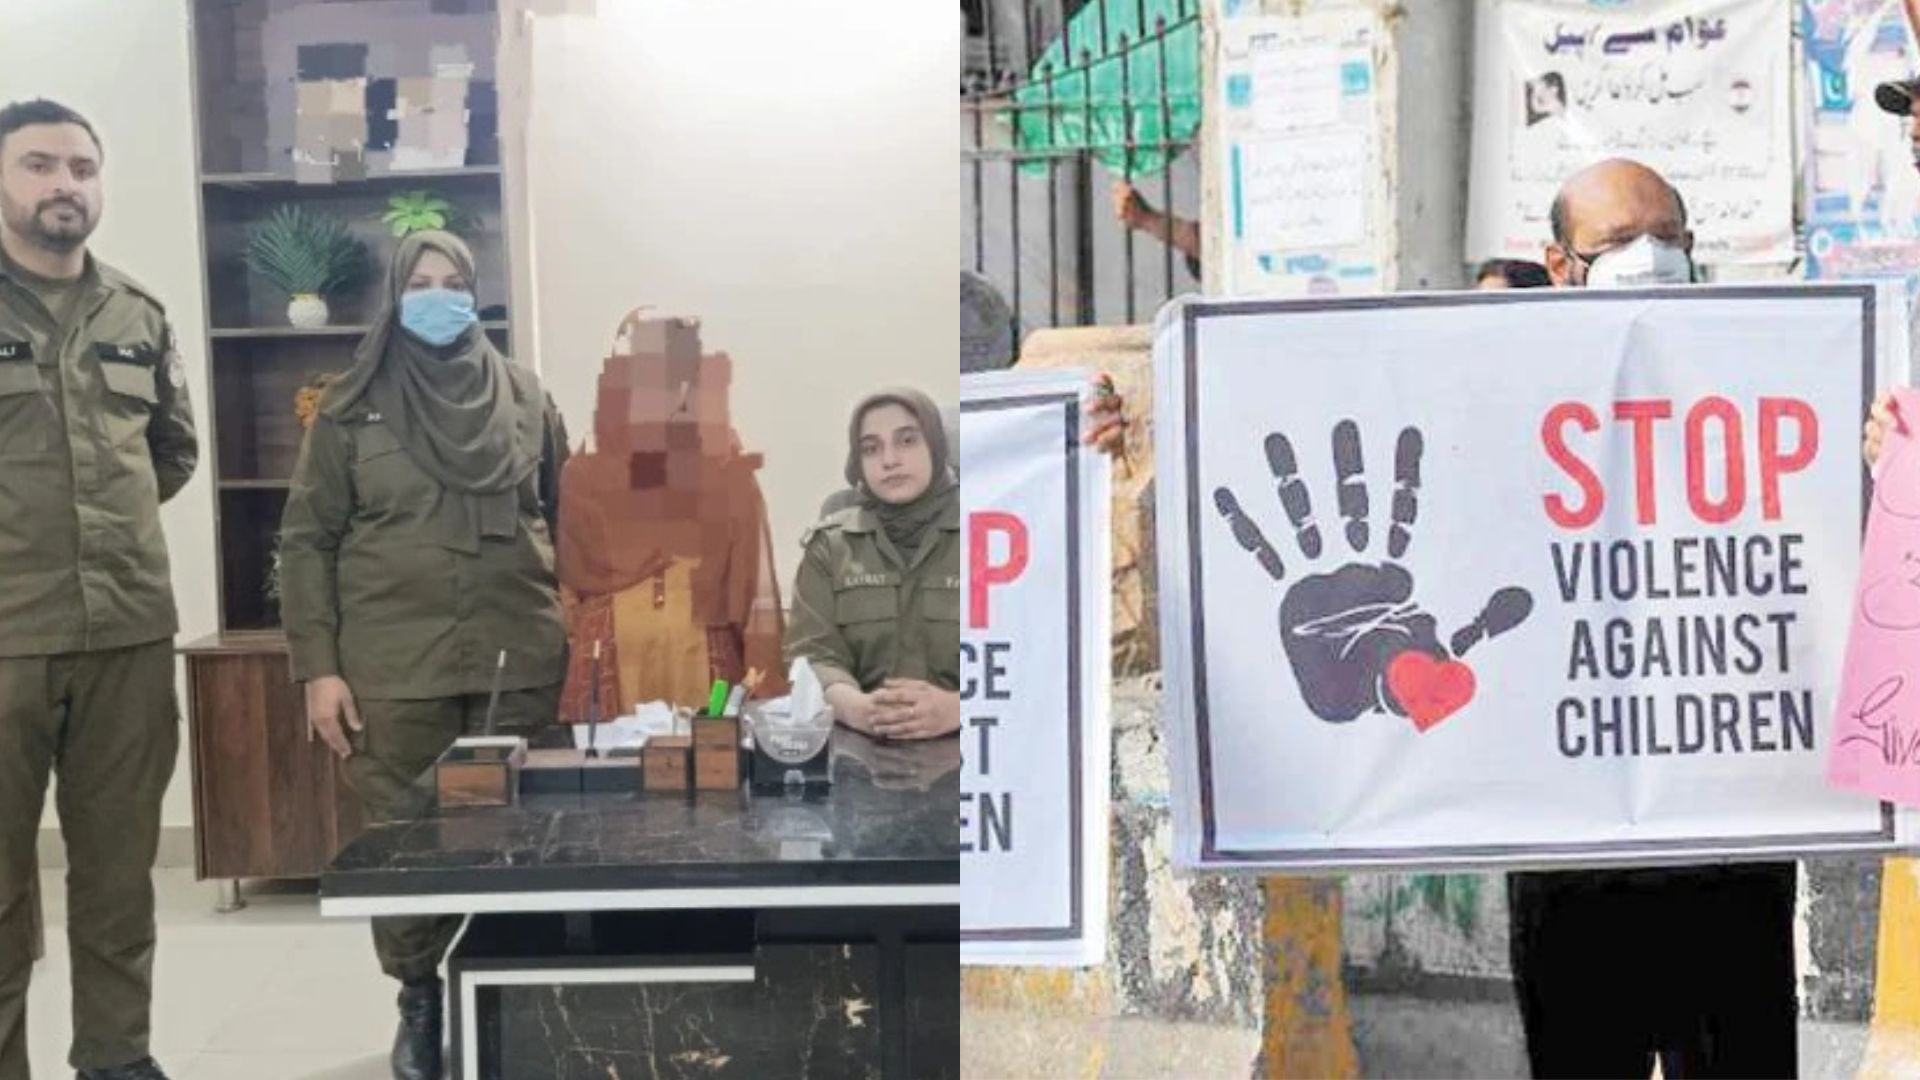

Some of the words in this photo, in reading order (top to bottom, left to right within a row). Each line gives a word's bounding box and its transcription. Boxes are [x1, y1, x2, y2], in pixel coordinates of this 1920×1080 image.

[1541, 395, 1819, 529] STOP
[969, 512, 1029, 629] P
[1551, 534, 1808, 602] VIOLENCE
[1567, 612, 1797, 680] AGAINST
[960, 717, 998, 775] T
[1556, 690, 1815, 758] CHILDREN
